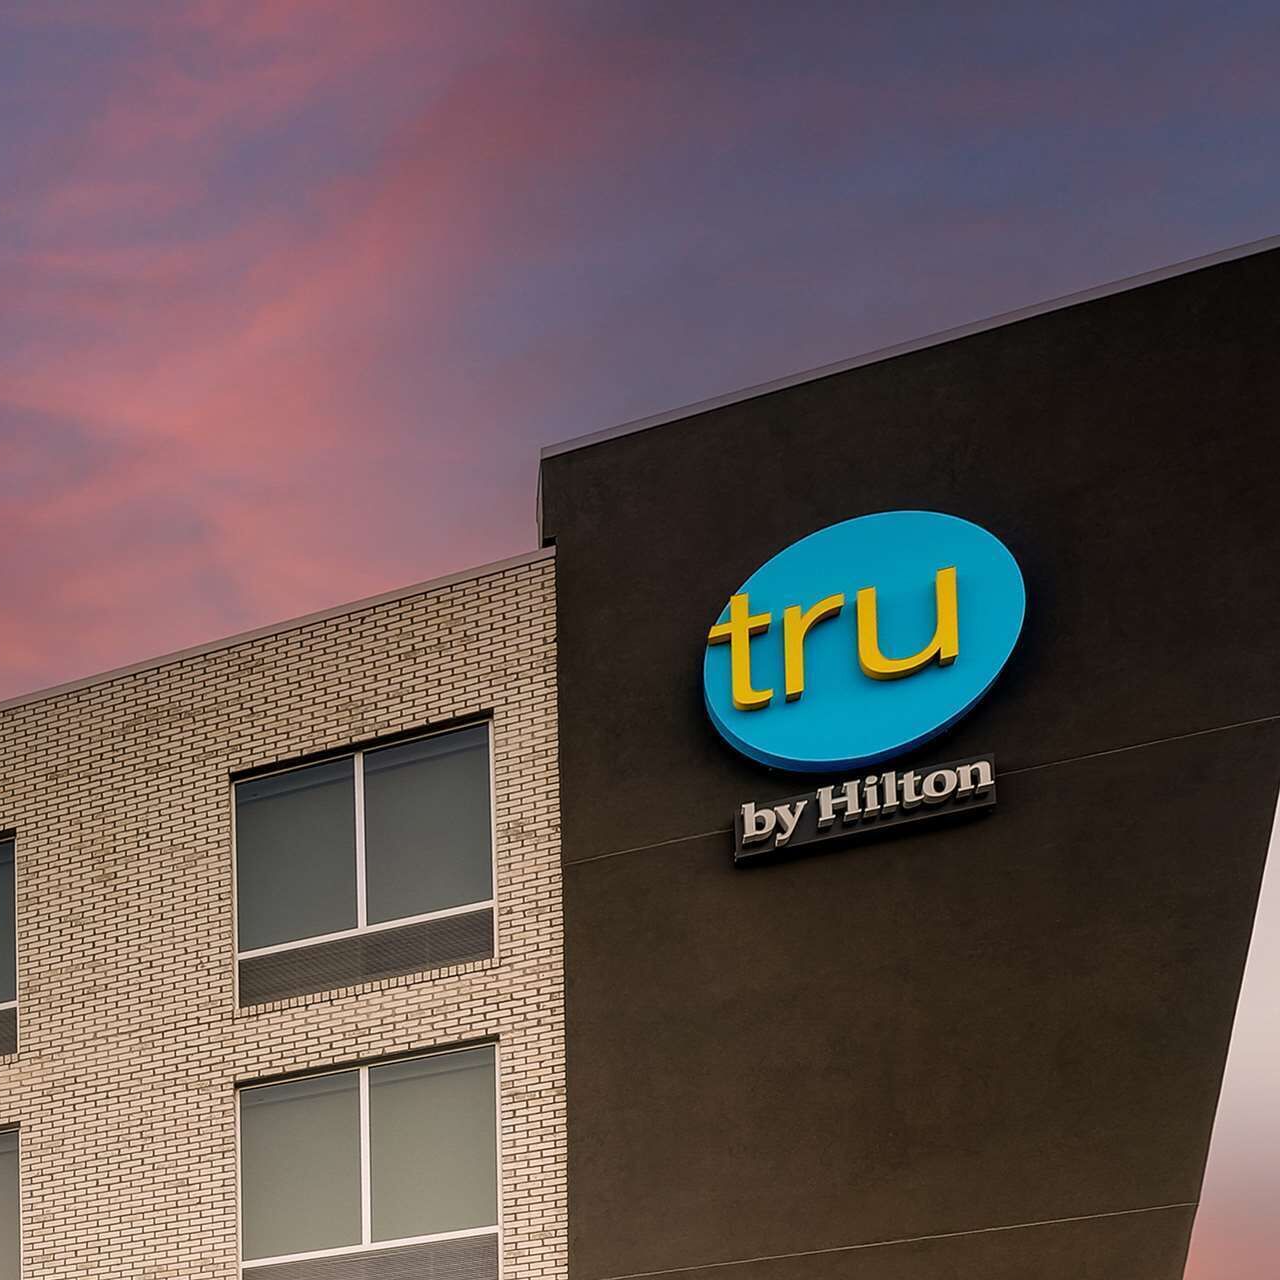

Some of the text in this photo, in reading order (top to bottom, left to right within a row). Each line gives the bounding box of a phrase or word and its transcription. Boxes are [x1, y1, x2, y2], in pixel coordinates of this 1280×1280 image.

[708, 566, 959, 711] tru
[742, 758, 995, 847] by Hilton
